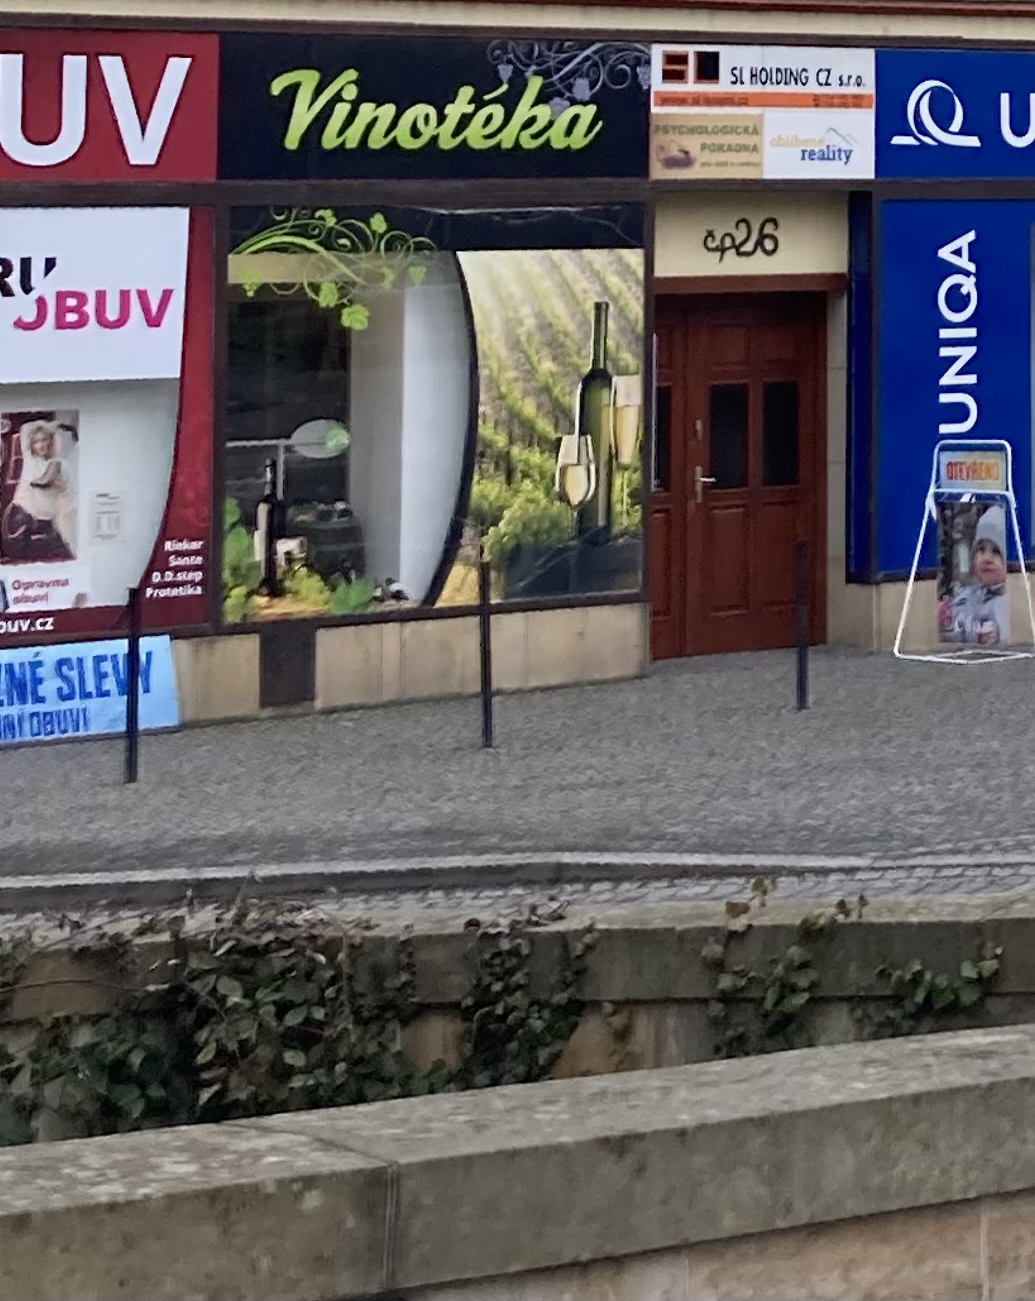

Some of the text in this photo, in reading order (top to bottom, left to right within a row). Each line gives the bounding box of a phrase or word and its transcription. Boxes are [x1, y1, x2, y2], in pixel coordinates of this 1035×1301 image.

[0, 54, 192, 166] UV
[270, 68, 603, 150] Vinotéka
[730, 66, 866, 88] SL HOLDING CZ s.r.o.
[800, 145, 854, 166] reality
[937, 230, 978, 434] UNIQA
[0, 651, 153, 707] NÉ SLEVY
